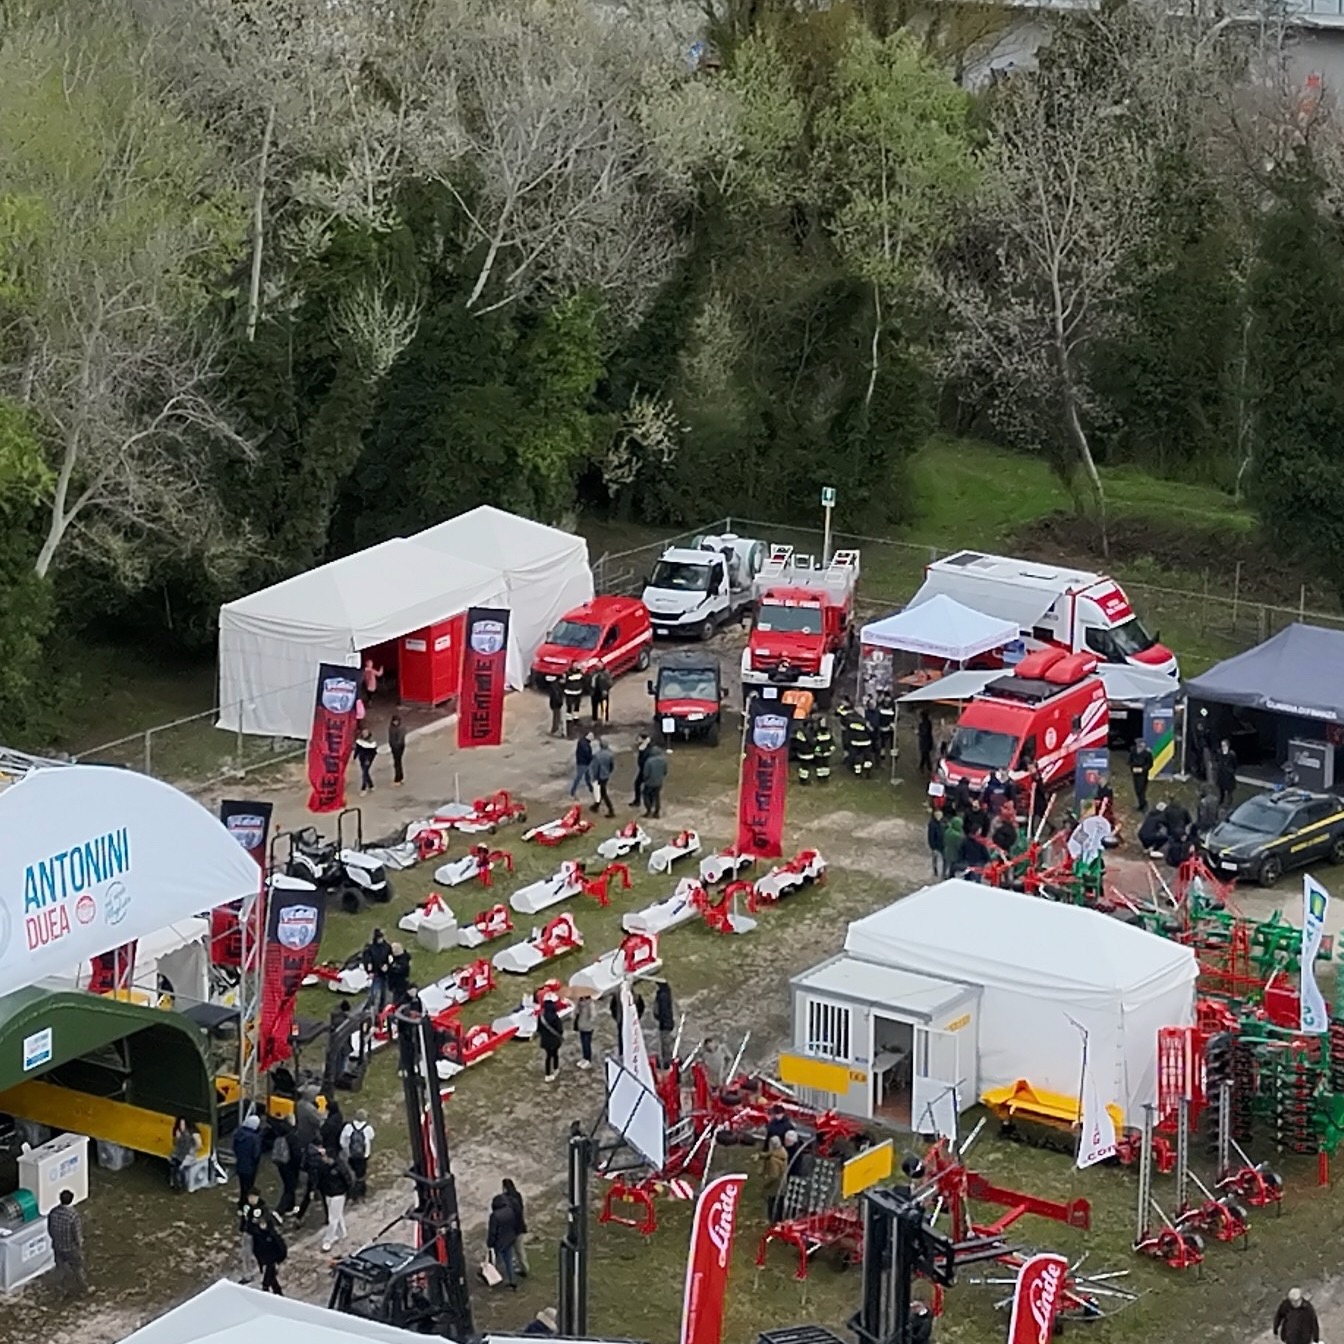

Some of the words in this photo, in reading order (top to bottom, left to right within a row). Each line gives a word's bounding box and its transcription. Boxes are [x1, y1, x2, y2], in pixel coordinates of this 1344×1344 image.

[25, 827, 130, 913] ANTONINI
[26, 904, 71, 951] DUEA
[708, 1184, 738, 1268] Linde
[1030, 1263, 1061, 1344] Linde
